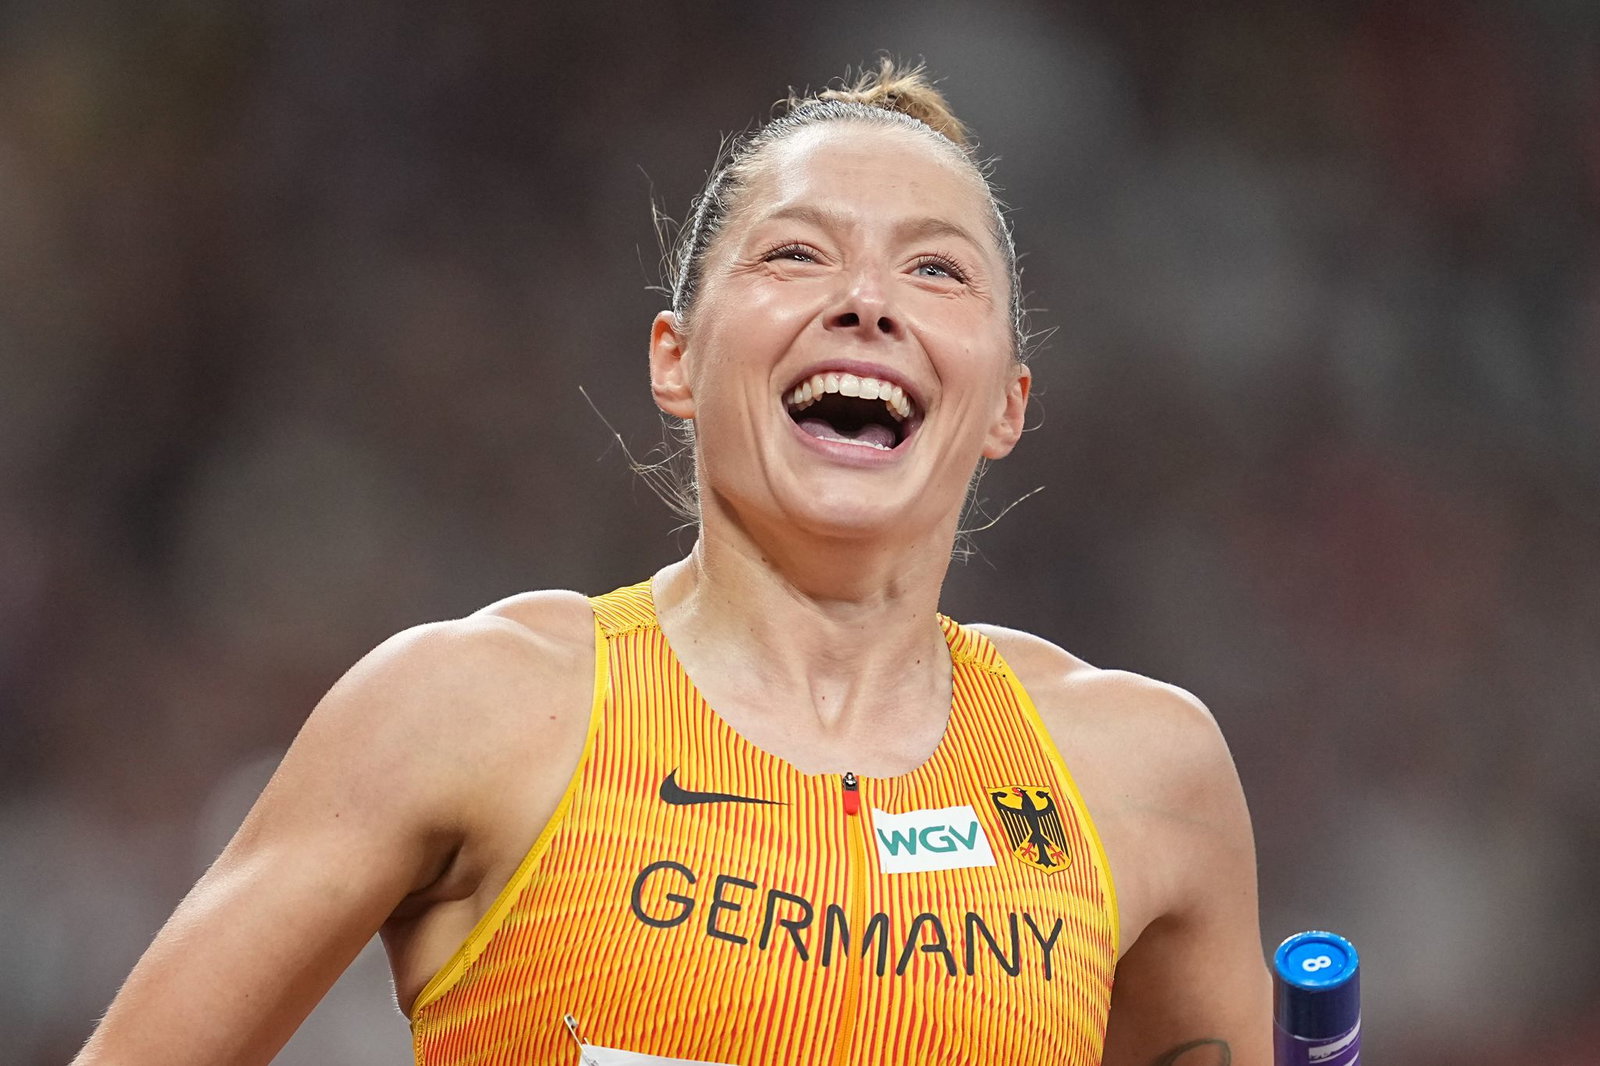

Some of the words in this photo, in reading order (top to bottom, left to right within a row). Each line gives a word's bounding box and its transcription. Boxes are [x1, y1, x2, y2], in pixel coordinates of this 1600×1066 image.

[877, 821, 979, 856] WGV
[631, 860, 1063, 981] GERMANY
[1302, 955, 1332, 972] 8
